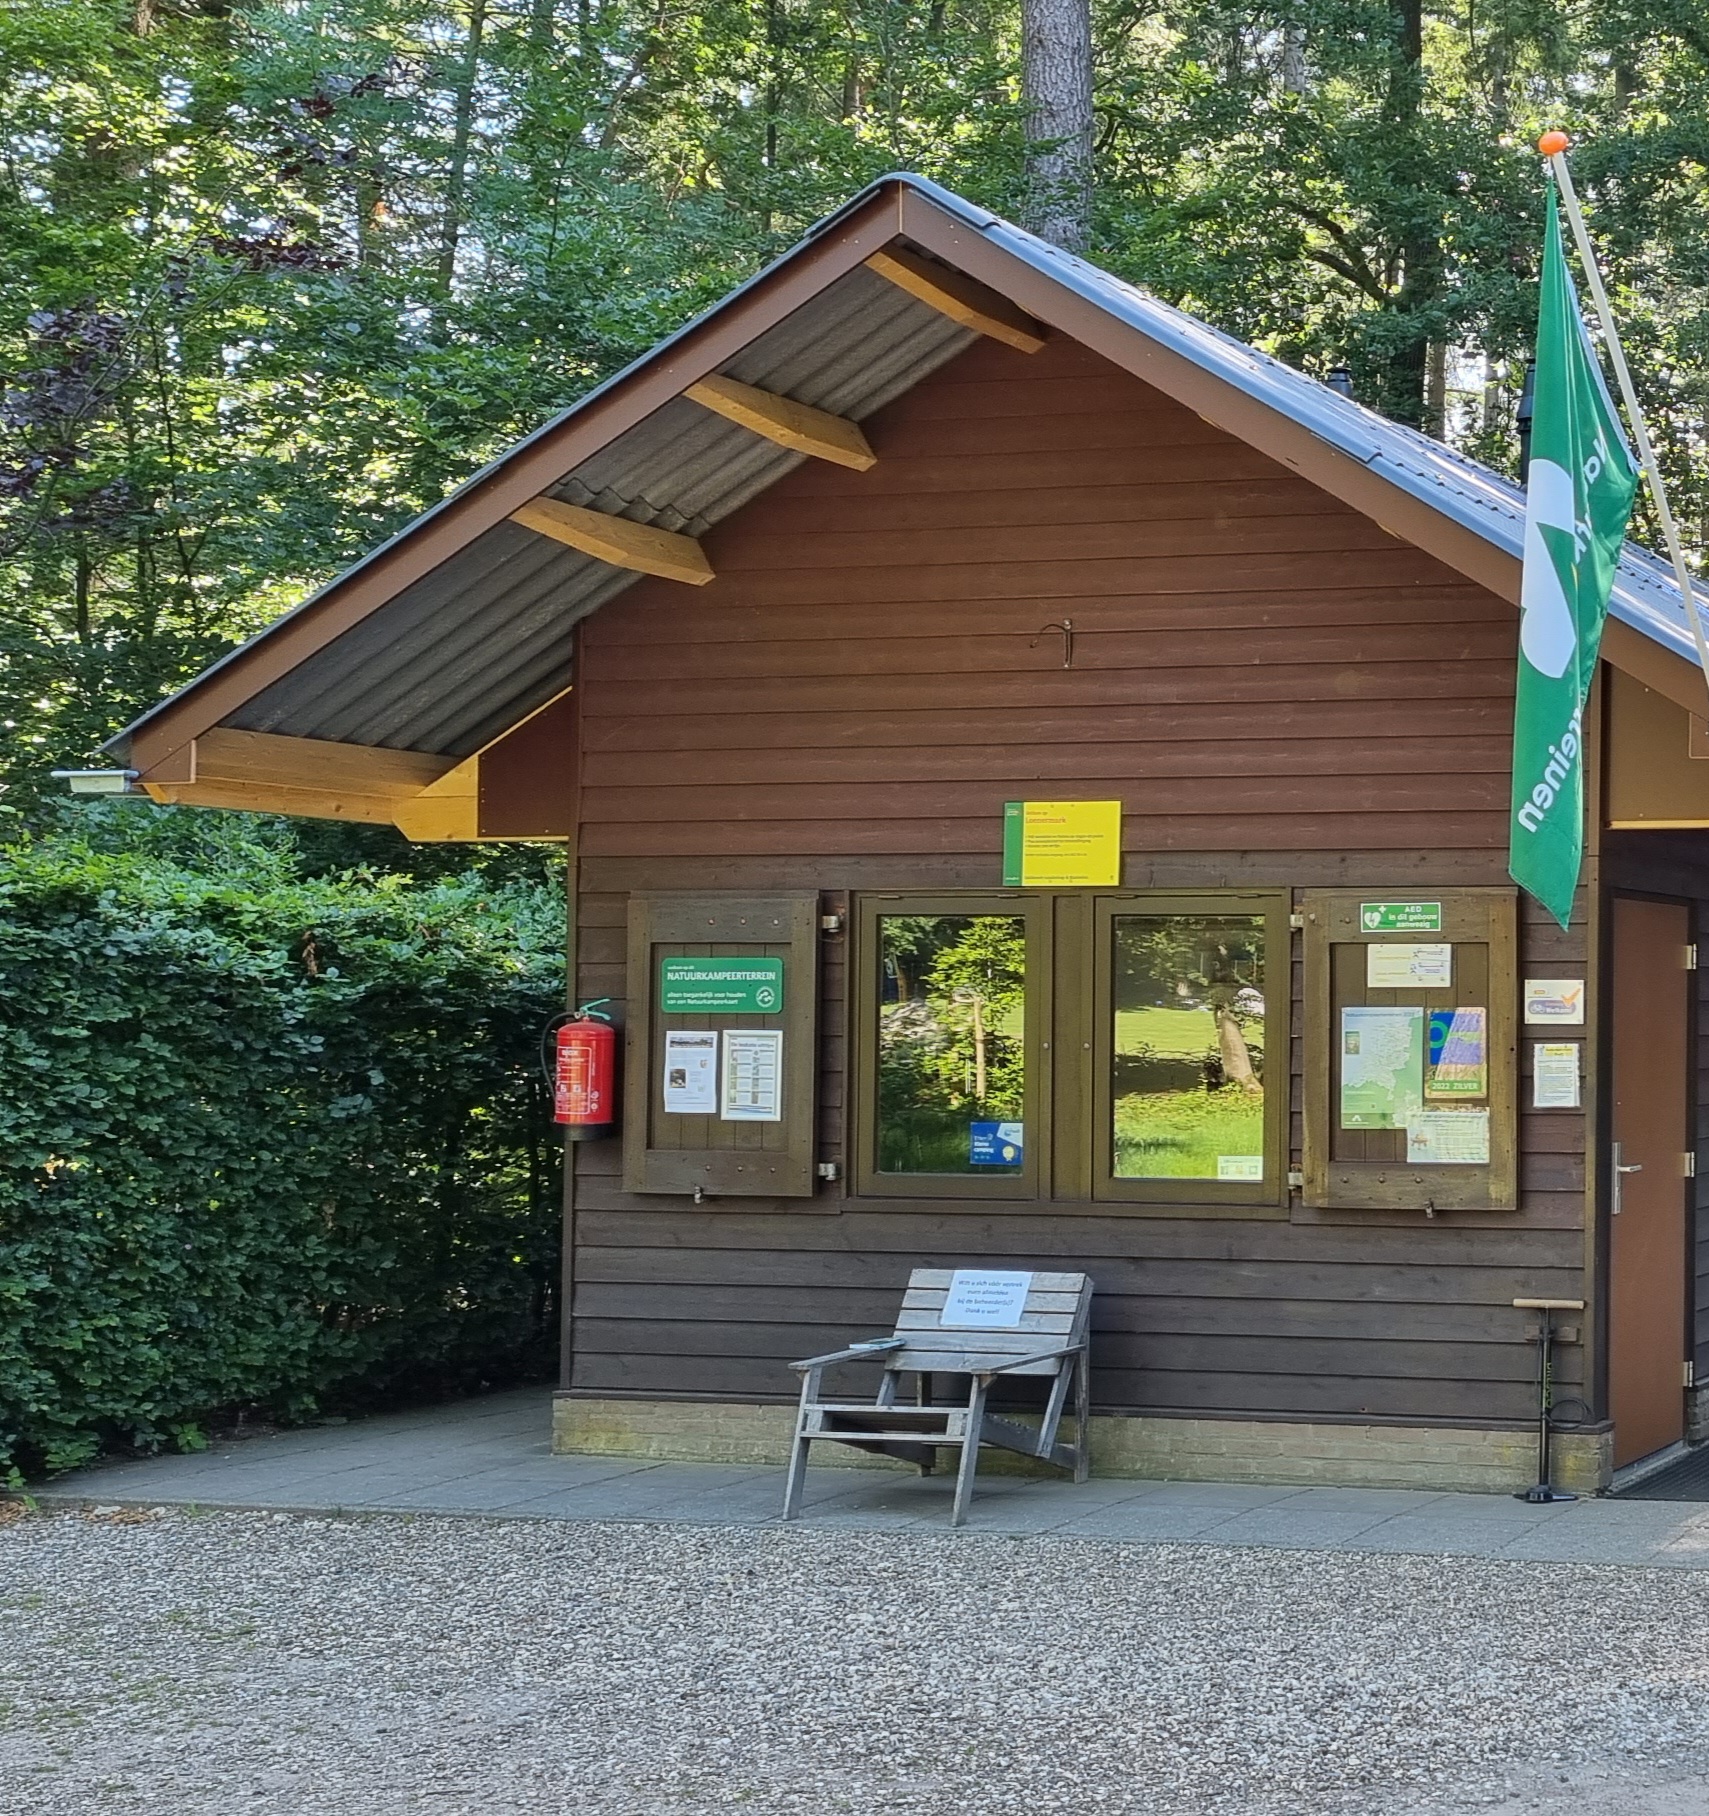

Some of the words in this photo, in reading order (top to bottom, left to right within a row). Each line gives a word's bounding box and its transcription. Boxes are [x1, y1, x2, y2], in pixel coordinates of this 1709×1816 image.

[667, 971, 776, 980] NATUURKAMPEERTERREIN
[1432, 1082, 1450, 1090] 2022
[1453, 1082, 1479, 1090] ZILVER
